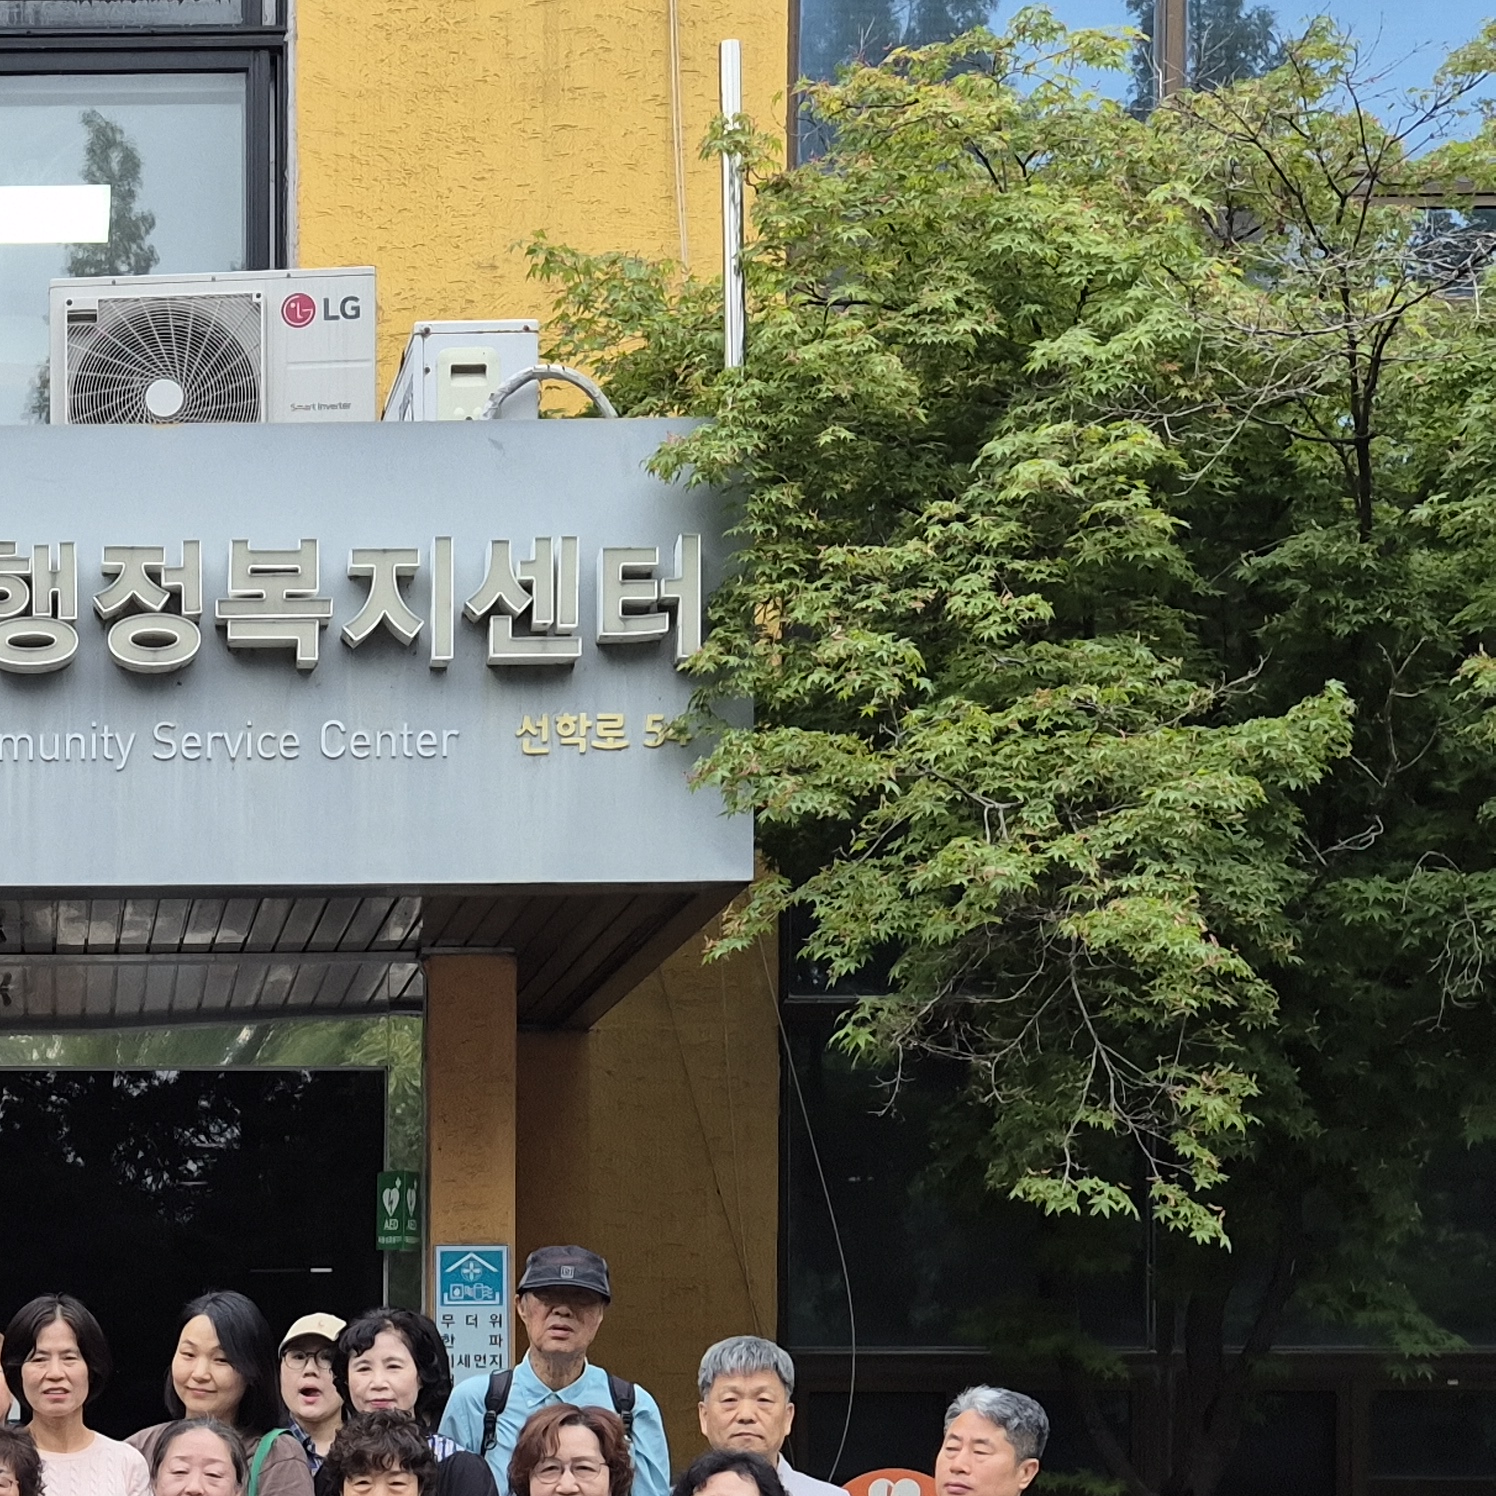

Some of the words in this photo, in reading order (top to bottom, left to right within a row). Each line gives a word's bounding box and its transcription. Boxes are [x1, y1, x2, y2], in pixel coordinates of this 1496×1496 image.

[323, 296, 361, 320] LG
[153, 721, 300, 762] Service
[320, 719, 460, 759] Center
[515, 713, 630, 755] 선학로
